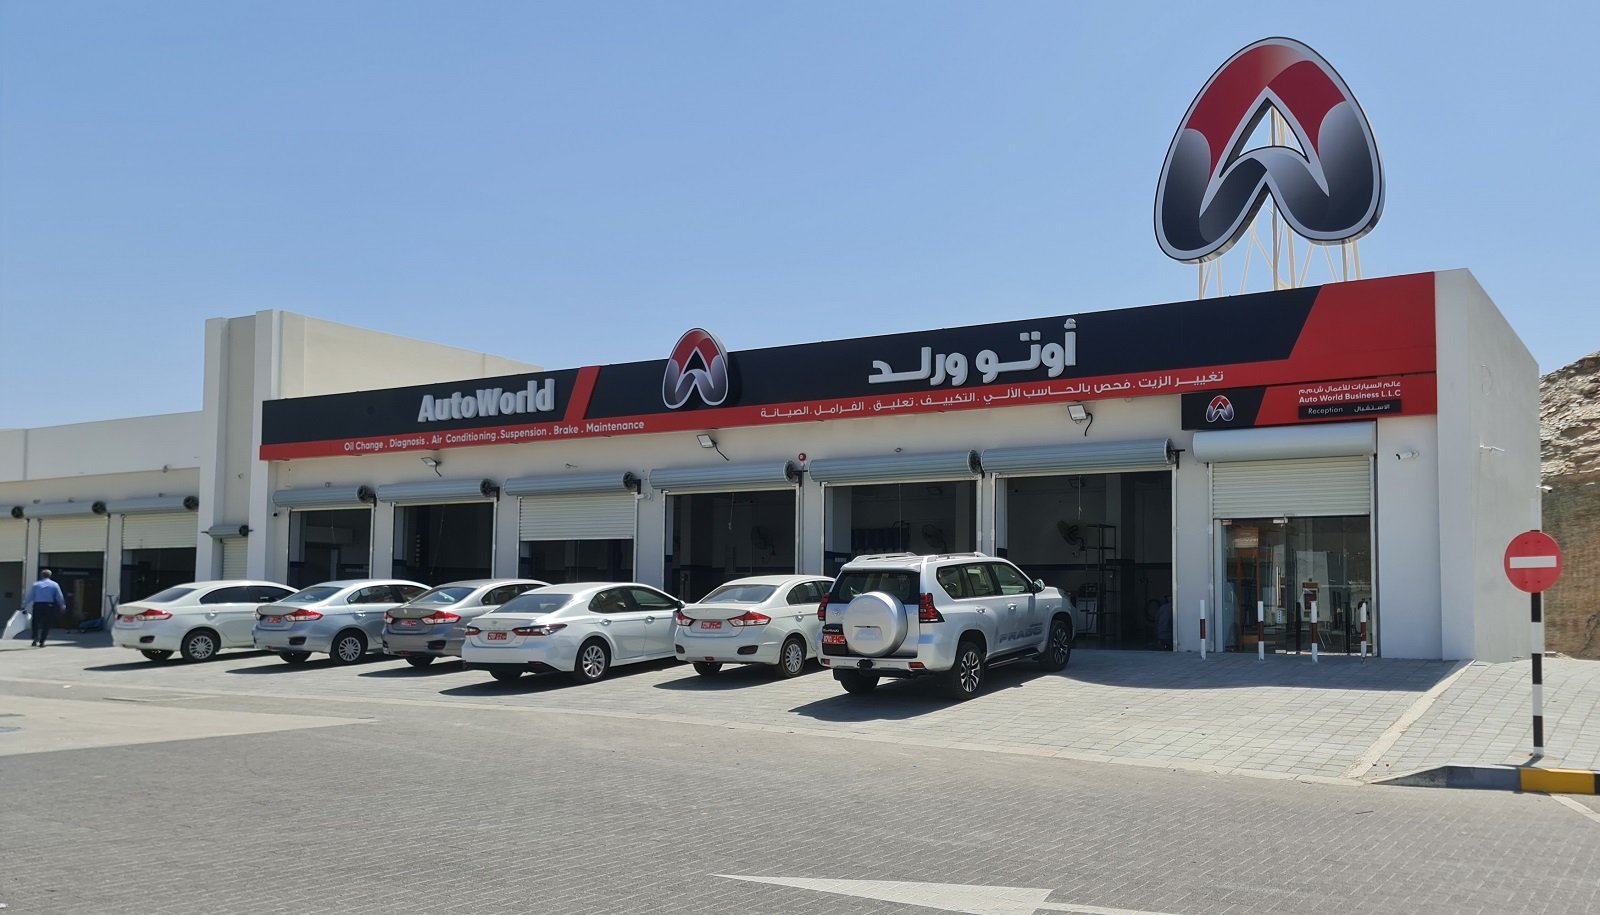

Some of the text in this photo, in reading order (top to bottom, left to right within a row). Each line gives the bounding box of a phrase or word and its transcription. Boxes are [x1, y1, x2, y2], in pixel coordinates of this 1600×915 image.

[868, 318, 1077, 386] أوتو ورلد
[1094, 379, 1131, 394] فحص
[1138, 375, 1172, 389] الزيت
[1174, 371, 1224, 388] تغيير
[1351, 382, 1382, 391] السيارات
[1023, 383, 1091, 399] بالحاسب
[1319, 394, 1343, 402] World
[1345, 391, 1379, 400] Business
[418, 378, 555, 422] AutoWorld
[873, 398, 914, 411] تعليق
[920, 392, 976, 406] التكييف
[760, 406, 809, 418] الصيانة
[814, 401, 865, 416] الفرامل
[1308, 407, 1344, 415] Reception
[344, 442, 354, 451] Oil
[355, 440, 384, 451] Change
[389, 437, 425, 448] Diagnosis
[431, 435, 442, 444] Air
[446, 430, 496, 443] Conditioning
[553, 425, 579, 434] Brake
[586, 421, 645, 433] Maintenance
